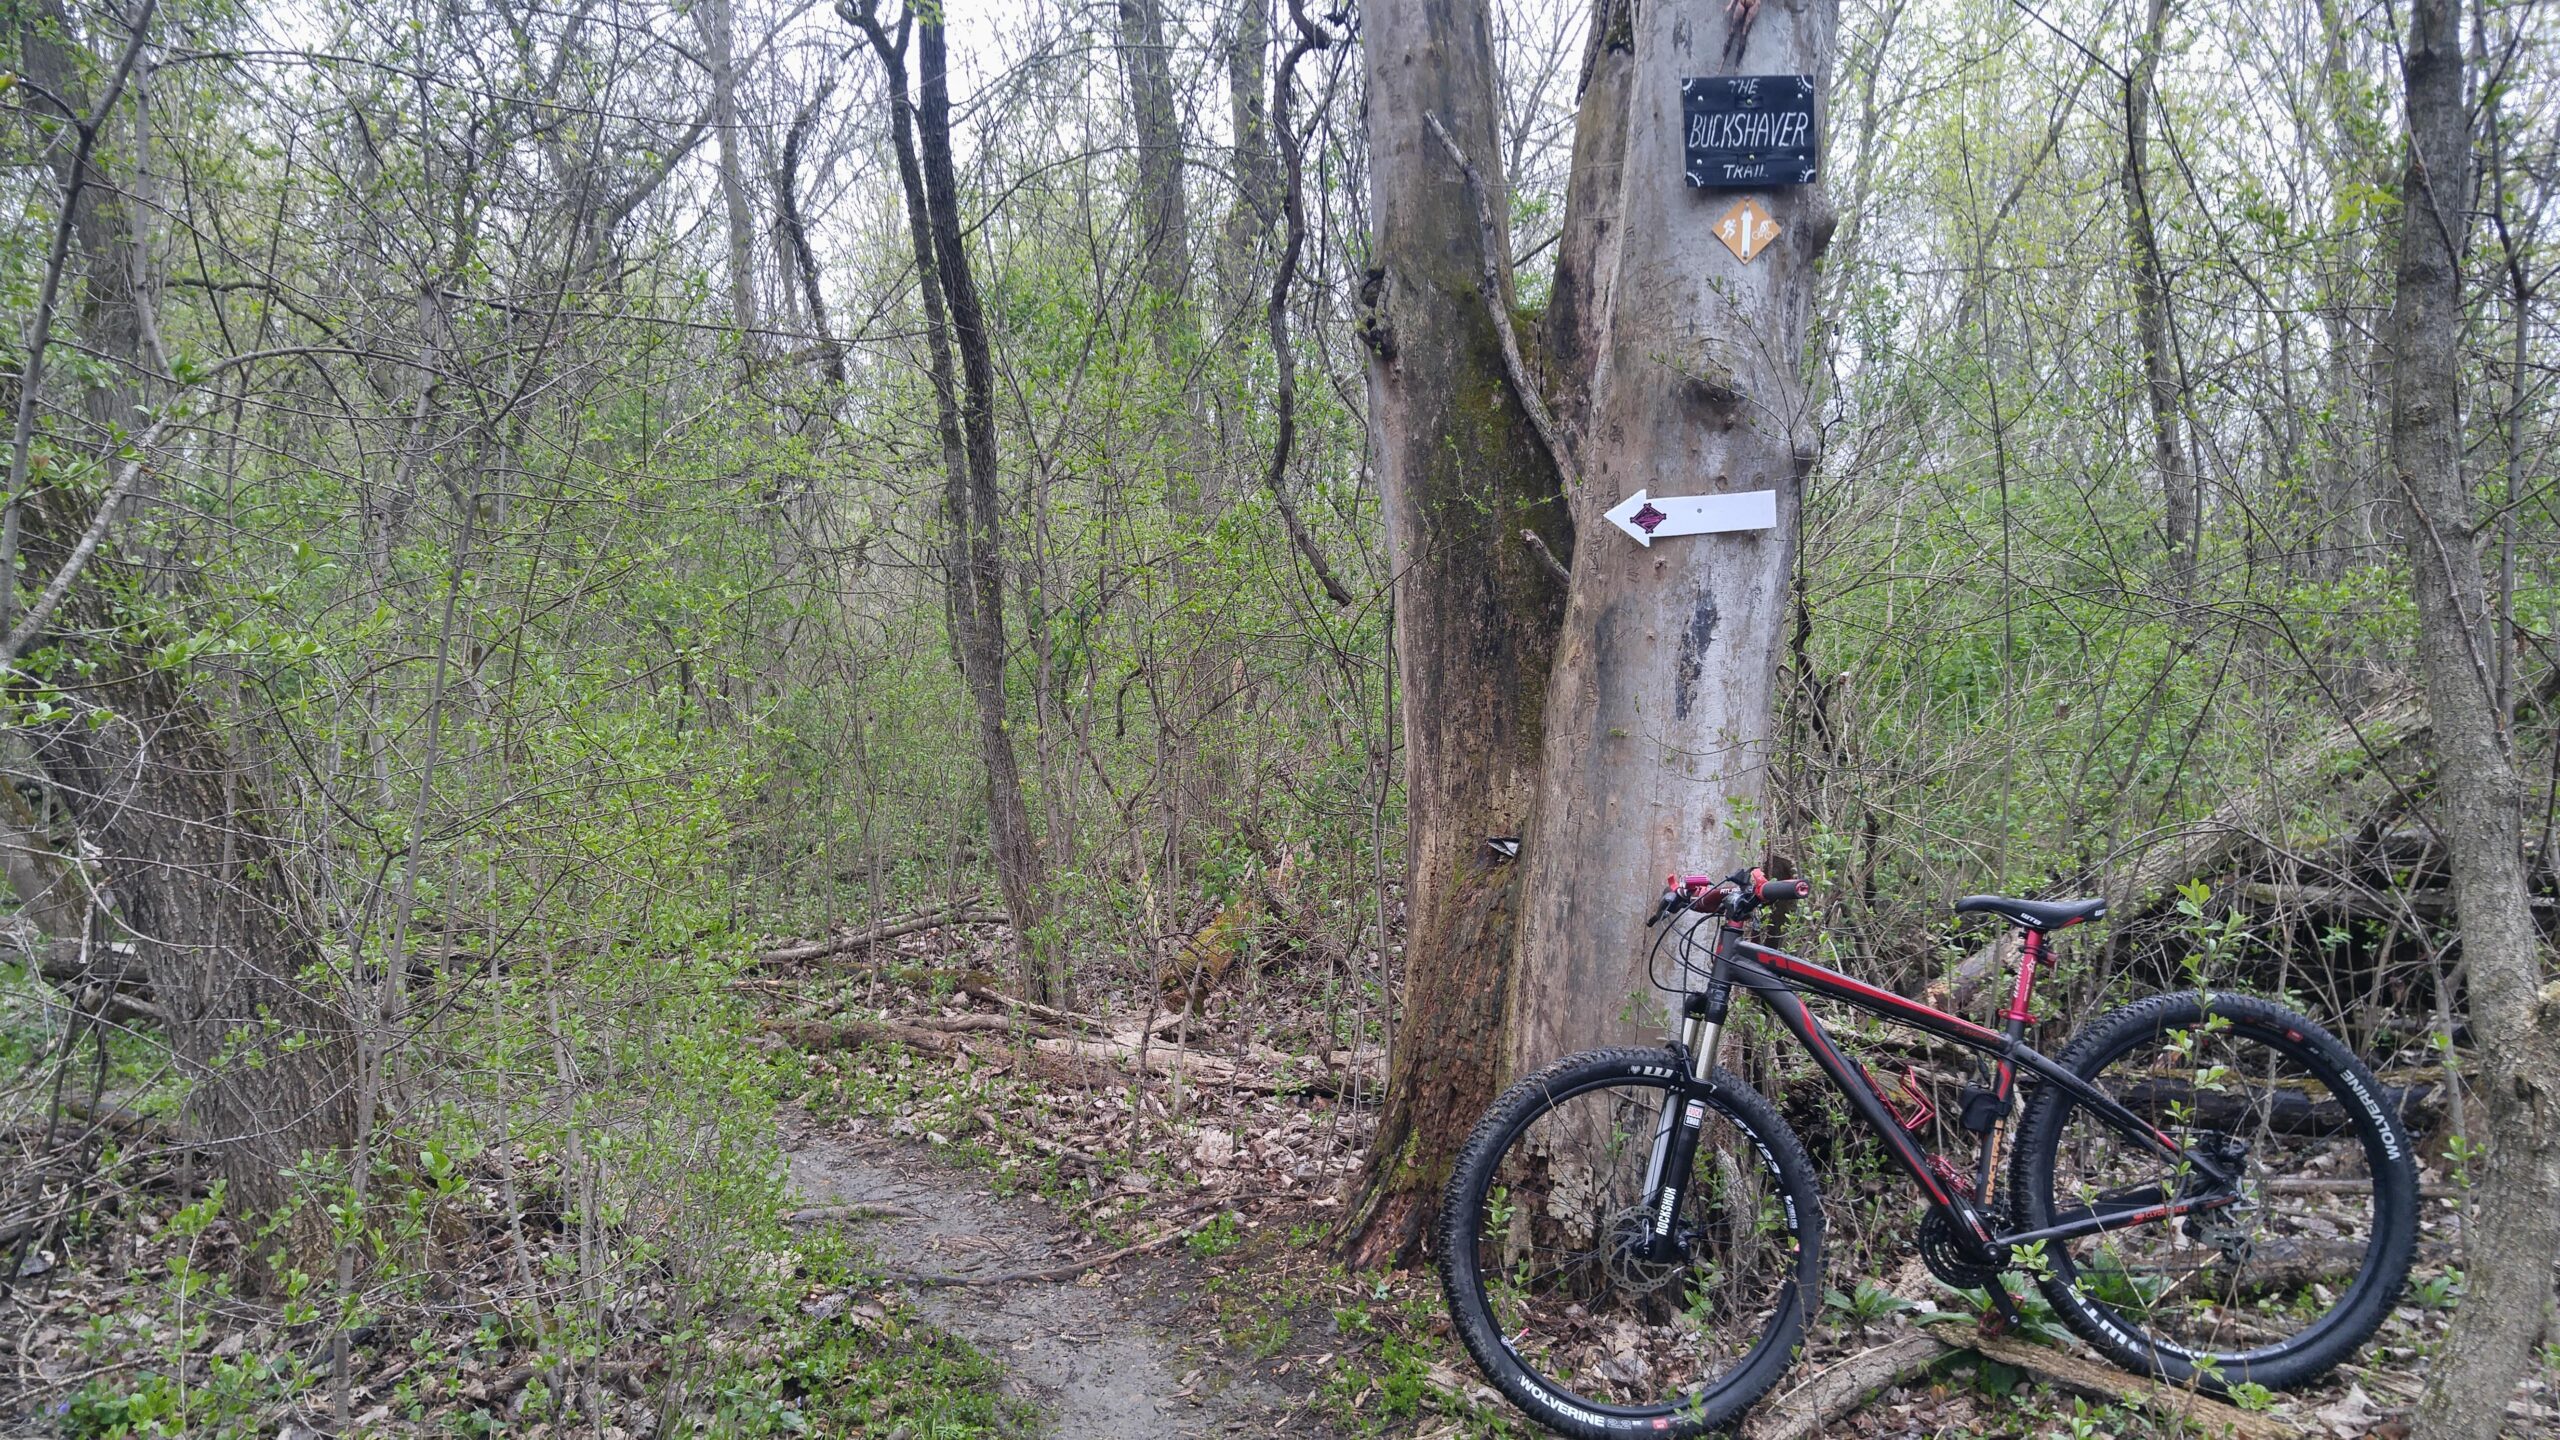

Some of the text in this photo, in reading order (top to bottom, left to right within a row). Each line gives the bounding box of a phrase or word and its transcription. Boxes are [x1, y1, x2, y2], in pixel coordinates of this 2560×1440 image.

[1728, 78, 1760, 94] THE
[1688, 112, 1809, 149] BUCKSHAVER
[1723, 164, 1769, 179] TRAIL
[2339, 1068, 2401, 1161] WOLVERINE
[1655, 1186, 1677, 1236] ROCKSHOX
[1519, 1375, 1605, 1428] WOLVERINE
